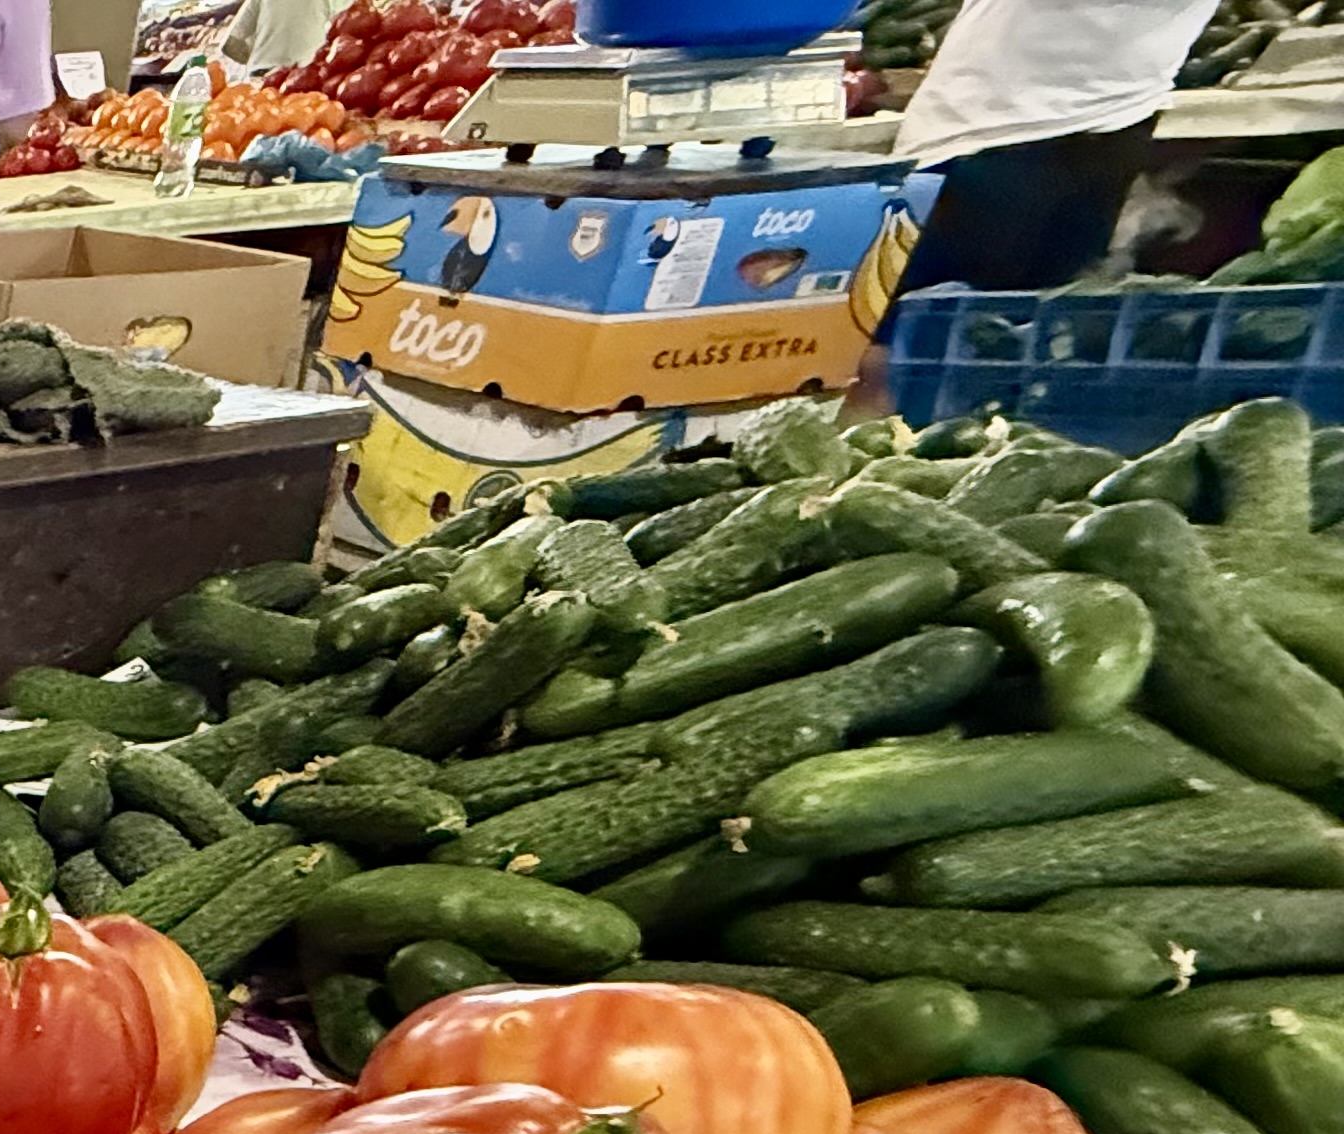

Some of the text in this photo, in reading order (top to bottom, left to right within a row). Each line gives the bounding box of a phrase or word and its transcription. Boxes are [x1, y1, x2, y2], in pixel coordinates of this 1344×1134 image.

[752, 207, 815, 238] toco
[389, 298, 487, 367] toco
[652, 338, 818, 370] CLASS EXTRA
